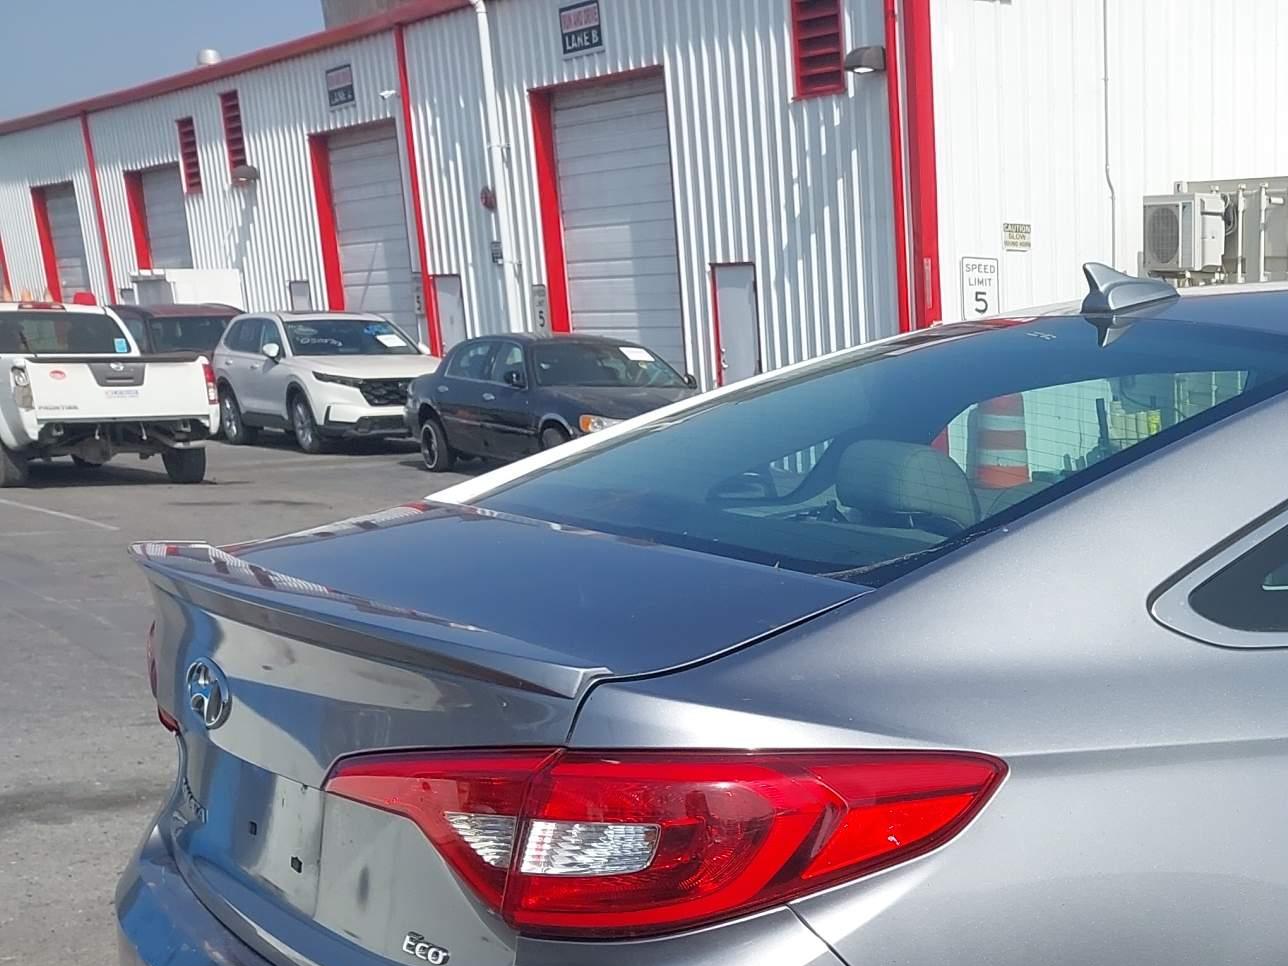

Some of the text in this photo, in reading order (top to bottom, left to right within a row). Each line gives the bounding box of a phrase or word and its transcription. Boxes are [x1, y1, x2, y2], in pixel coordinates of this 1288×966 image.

[565, 29, 599, 50] LANE B
[1003, 223, 1031, 233] CAUTION
[965, 263, 996, 274] SPEED
[968, 276, 992, 287] LIMIT
[974, 290, 989, 314] 5
